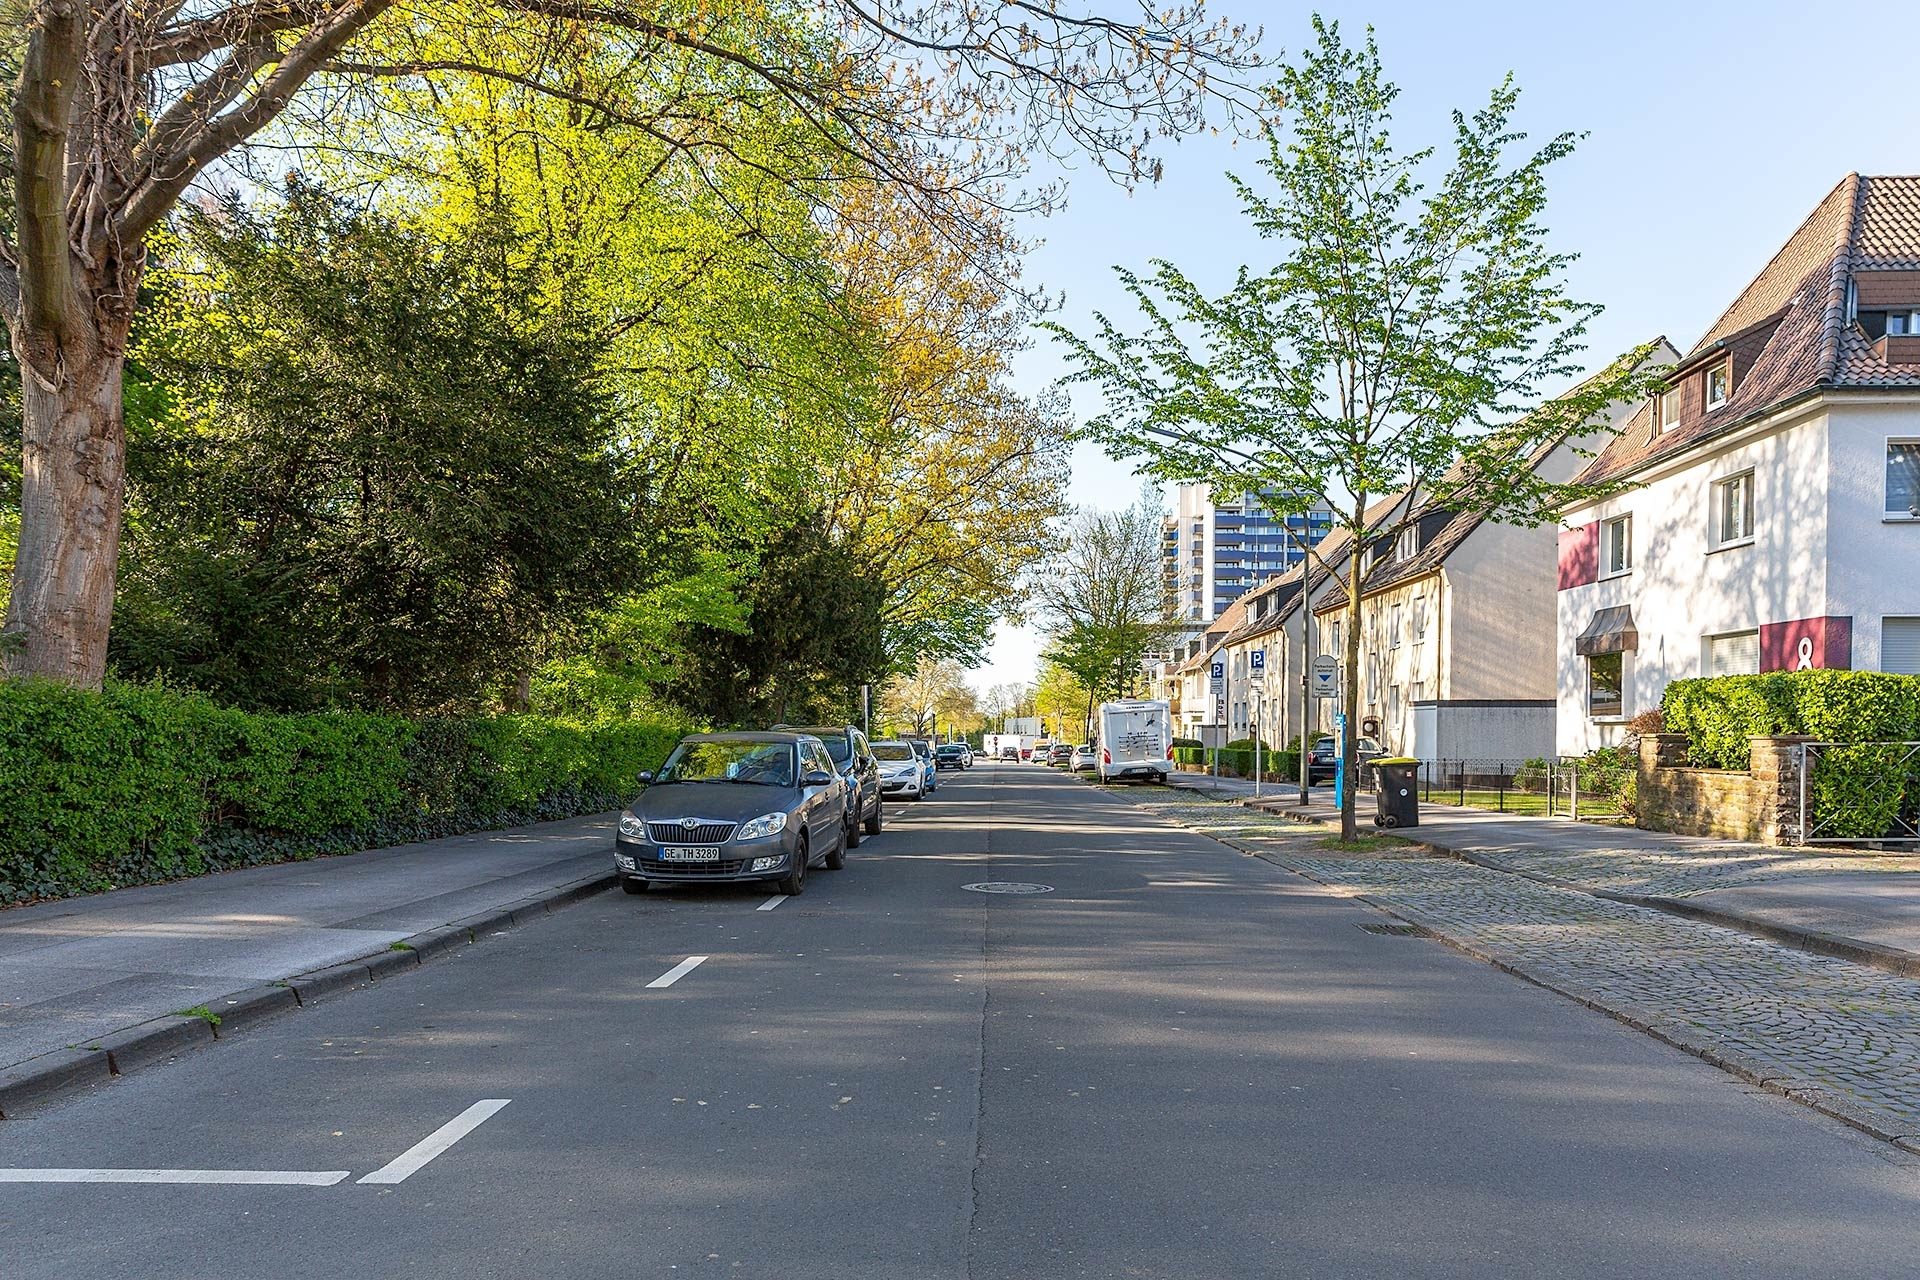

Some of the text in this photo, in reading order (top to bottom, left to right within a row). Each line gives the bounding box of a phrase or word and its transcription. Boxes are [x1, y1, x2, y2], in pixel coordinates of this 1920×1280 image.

[1253, 653, 1261, 667] P
[1797, 637, 1813, 670] 8
[1213, 665, 1220, 677] P
[664, 848, 718, 859] GE TH 3289
